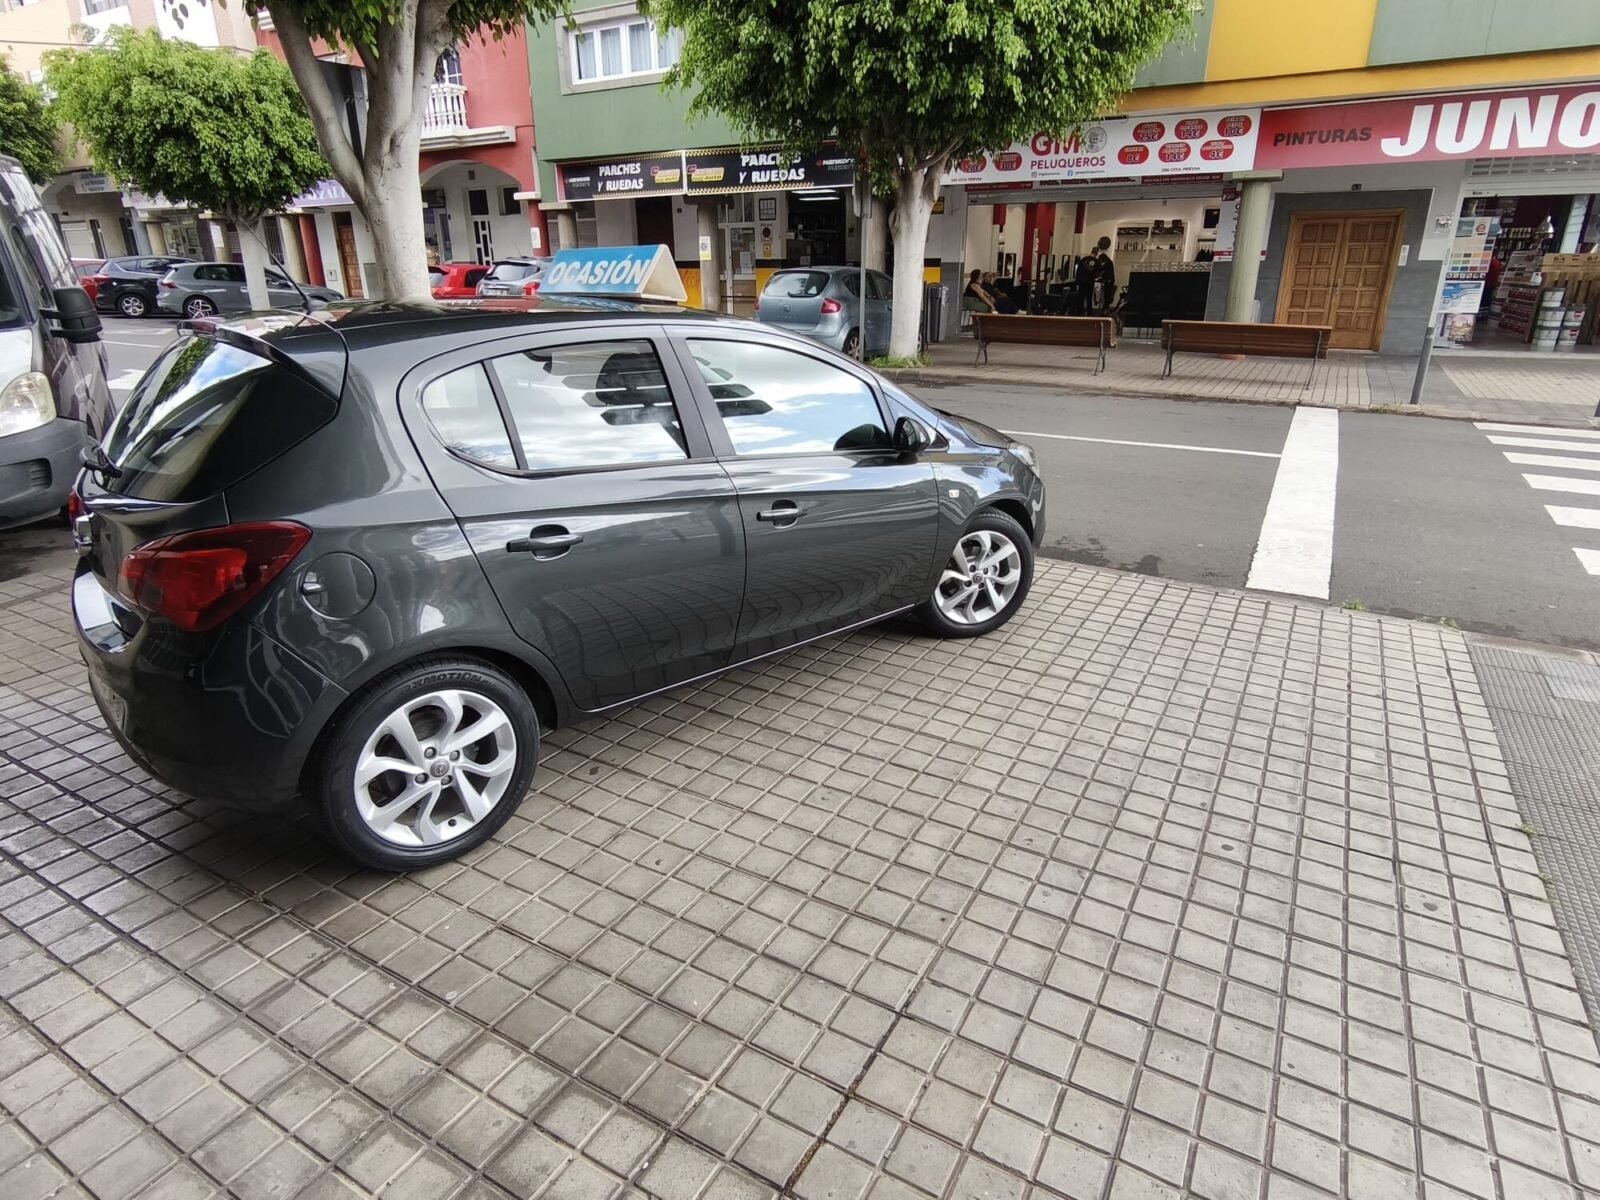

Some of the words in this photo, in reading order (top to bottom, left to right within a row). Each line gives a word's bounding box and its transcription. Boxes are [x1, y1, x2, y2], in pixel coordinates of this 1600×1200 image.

[1380, 92, 1600, 157] JUNO
[1031, 128, 1081, 156] GM
[1273, 127, 1373, 147] PINTURAS
[741, 151, 801, 167] PARCHS
[1030, 156, 1106, 170] PELUQUEROS
[599, 163, 642, 177] PARCHES
[739, 171, 747, 184] Y
[752, 168, 805, 183] RUEDAS
[598, 181, 603, 192] Y
[606, 179, 644, 191] RUEDAS
[548, 254, 650, 285] OCASIÓN
